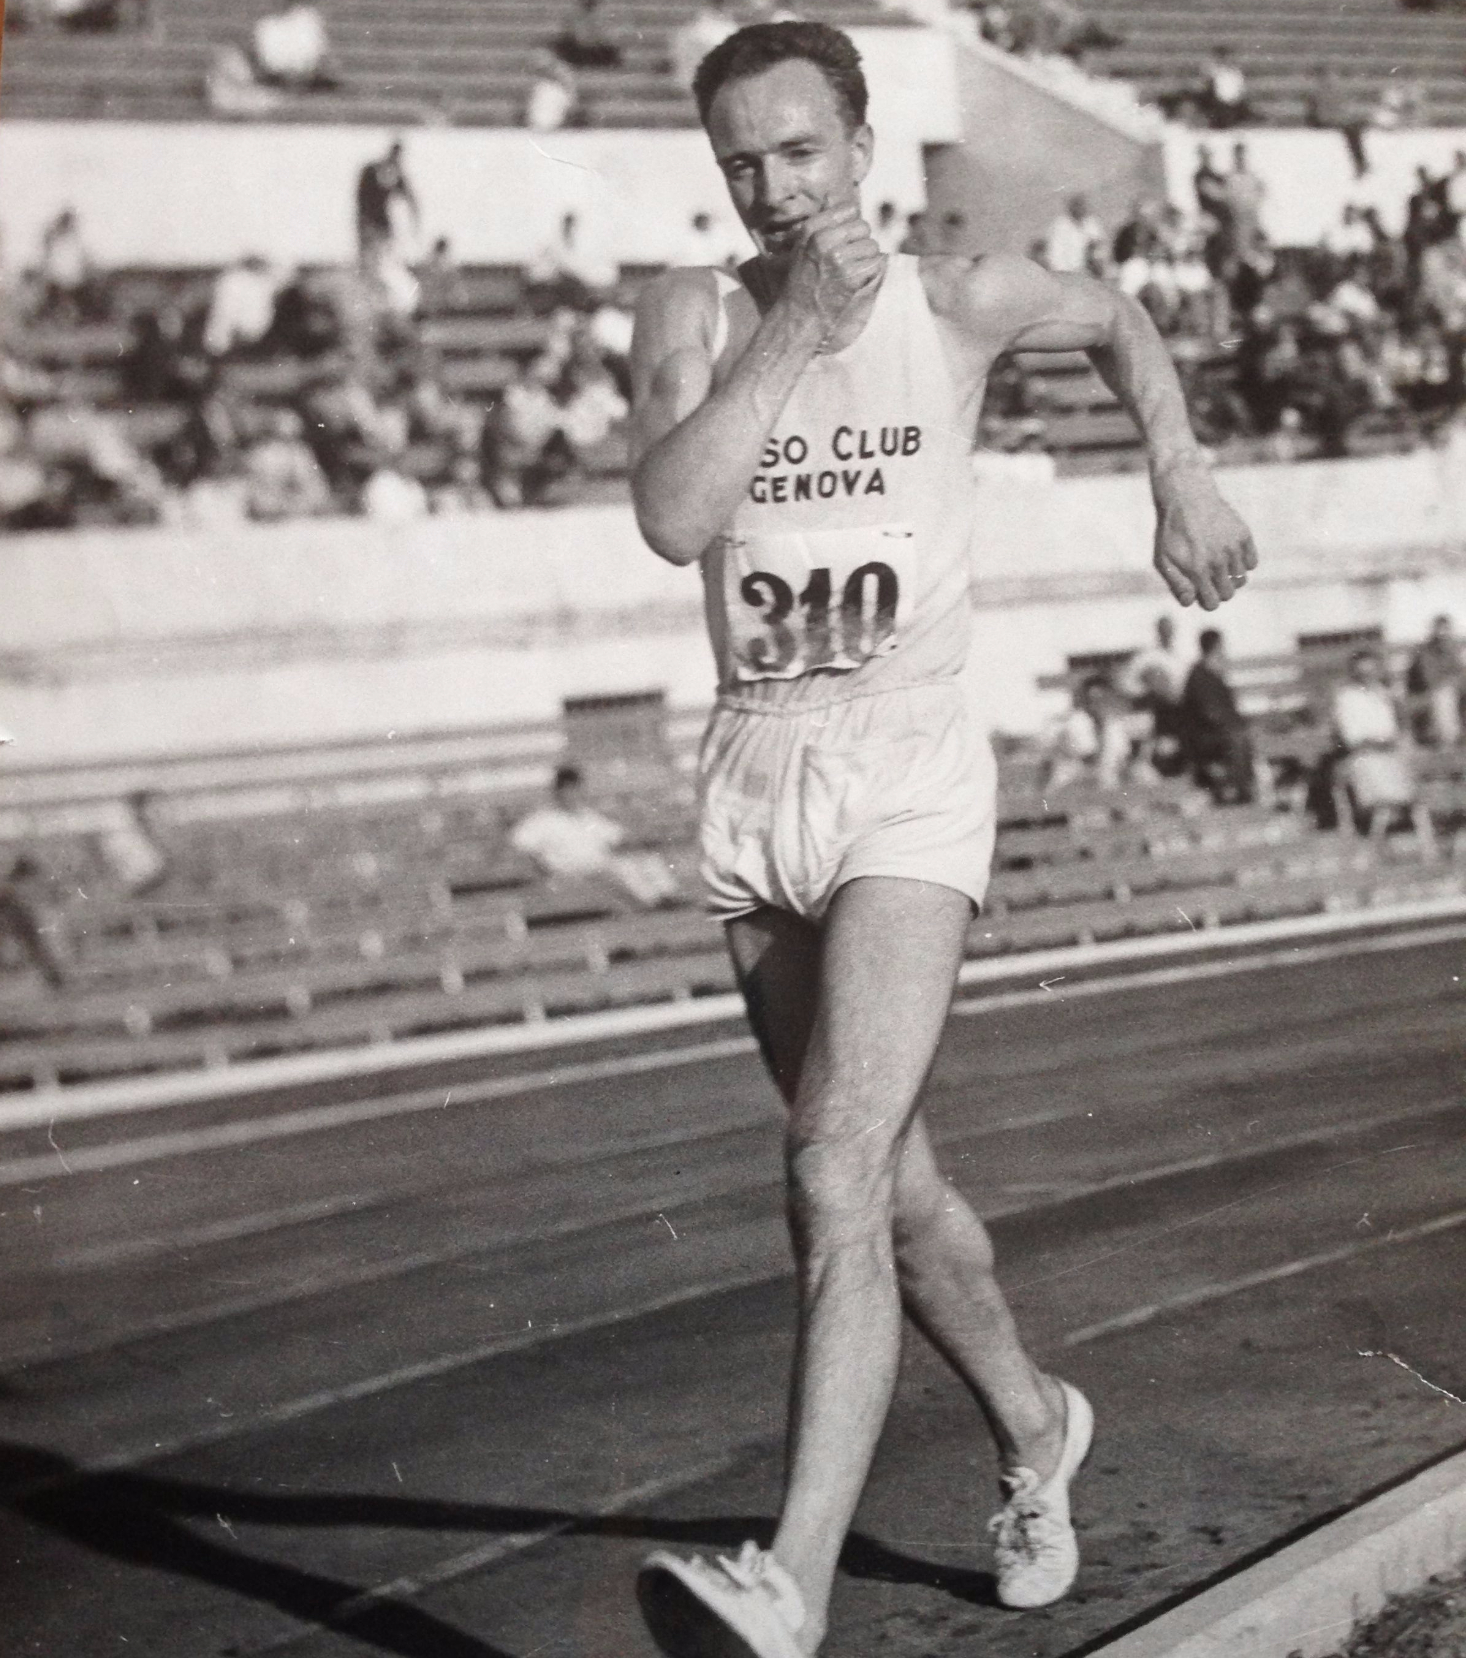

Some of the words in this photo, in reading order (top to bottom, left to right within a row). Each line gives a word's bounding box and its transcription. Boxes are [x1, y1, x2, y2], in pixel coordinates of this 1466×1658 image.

[832, 425, 922, 461] CLUB
[750, 467, 886, 503] GENOVA
[740, 561, 899, 672] 310
